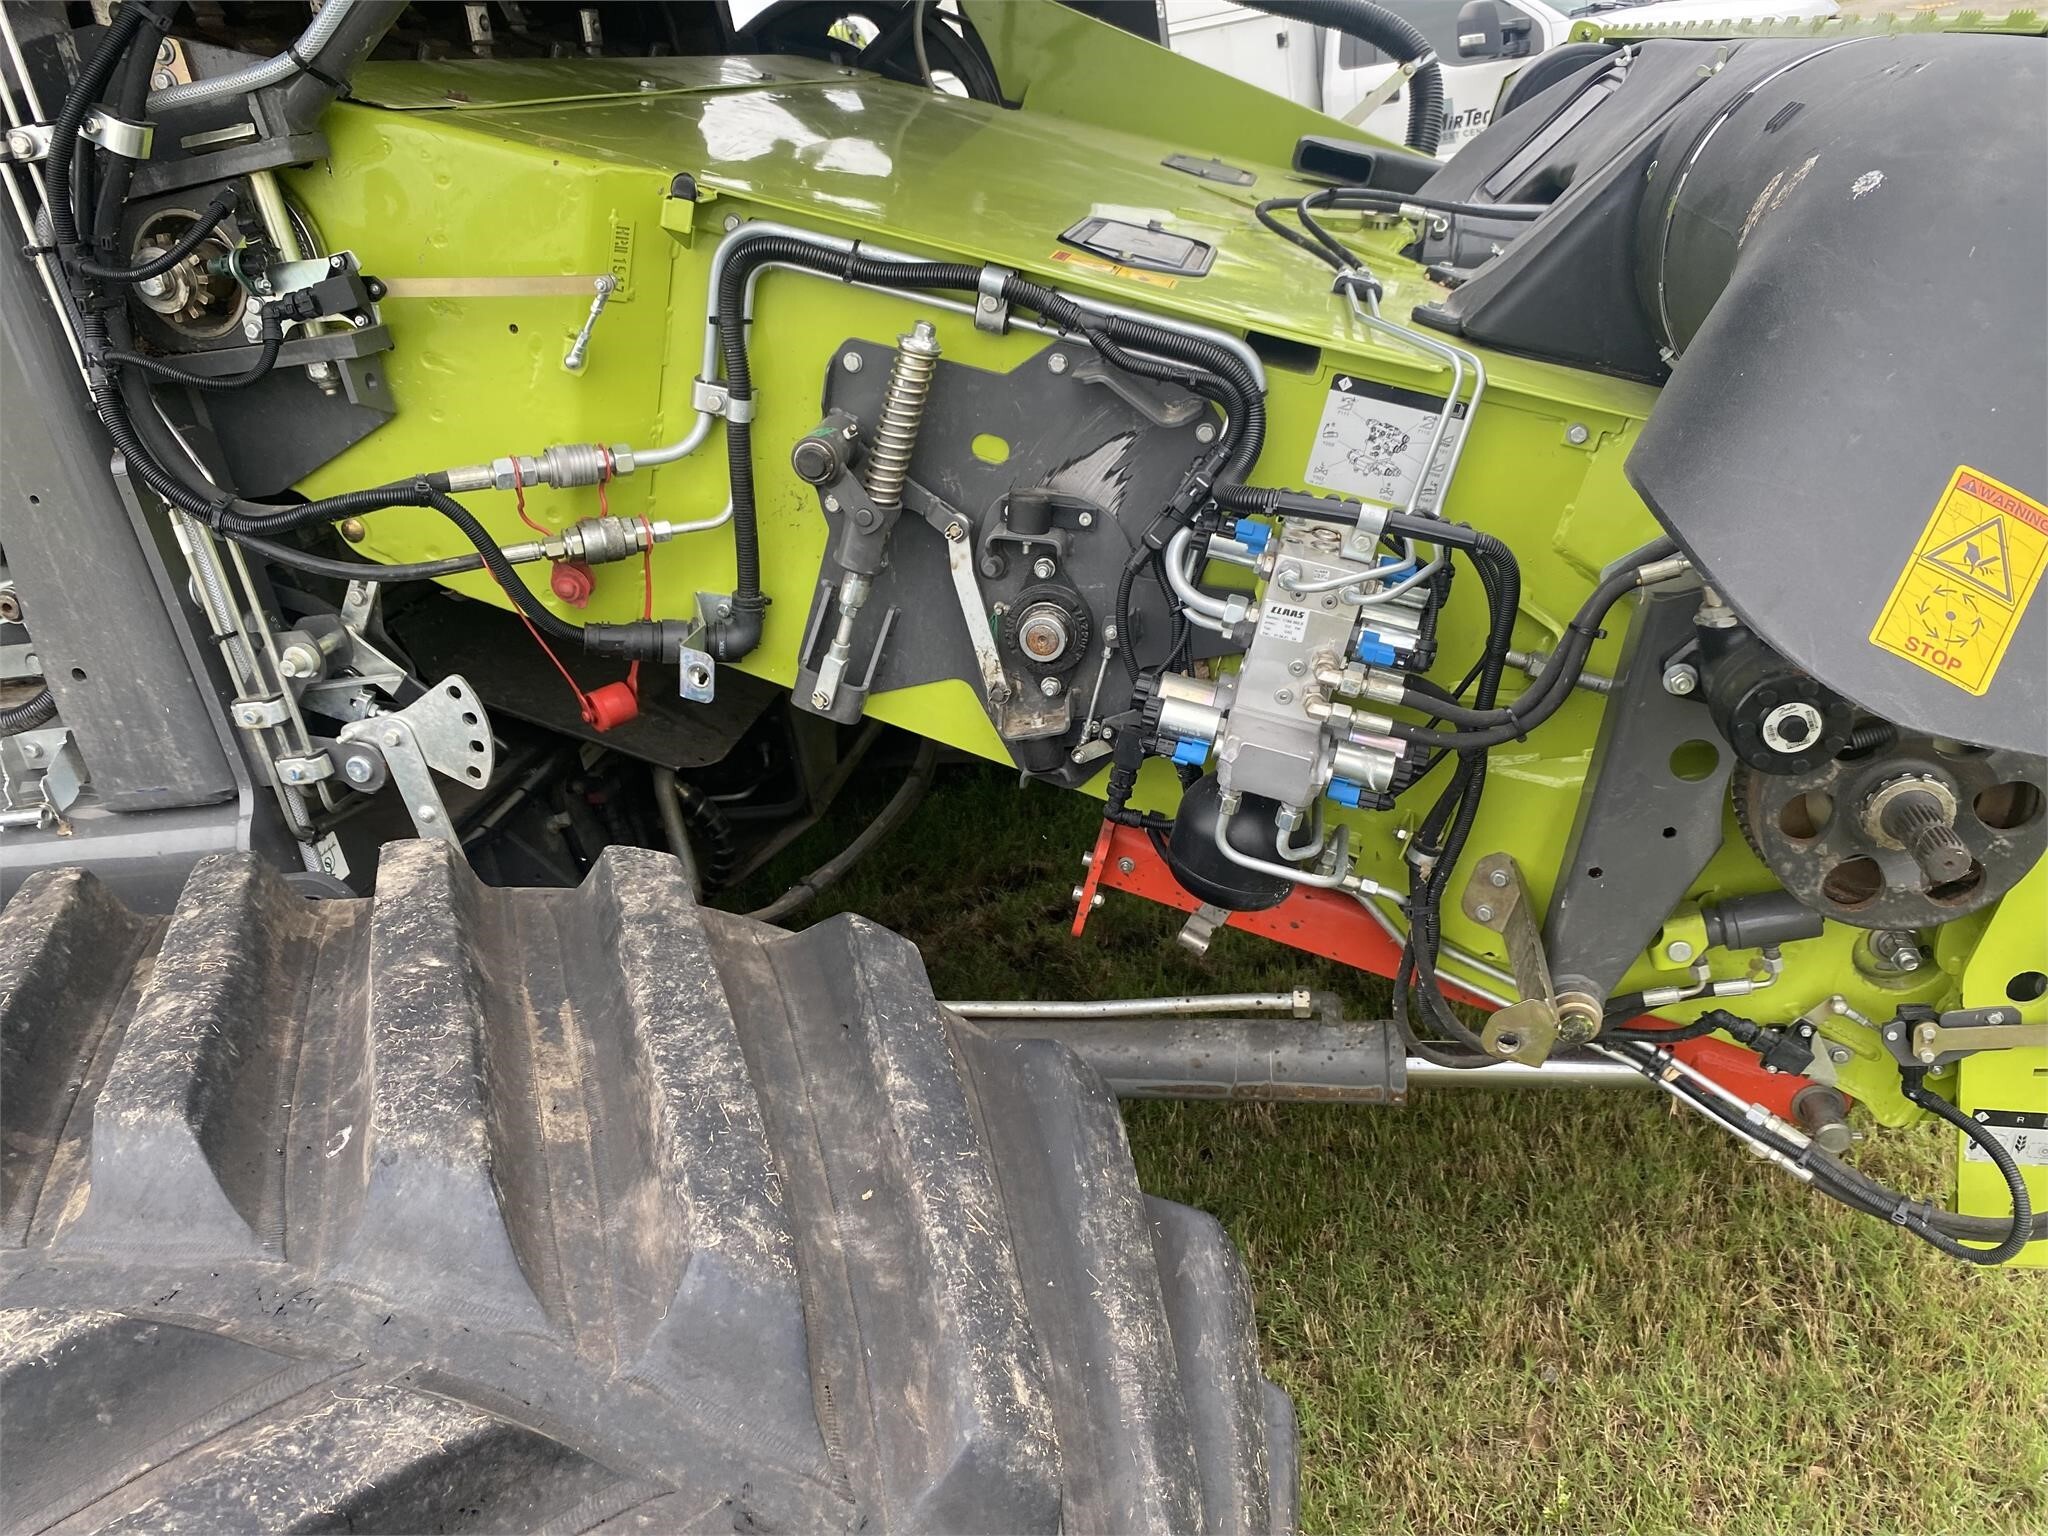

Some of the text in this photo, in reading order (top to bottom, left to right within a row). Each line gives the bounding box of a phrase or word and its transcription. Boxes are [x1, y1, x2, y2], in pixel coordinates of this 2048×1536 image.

[1981, 486, 2048, 532] WARNING
[1271, 606, 1305, 619] CLAAS
[1904, 636, 1963, 670] STOP
